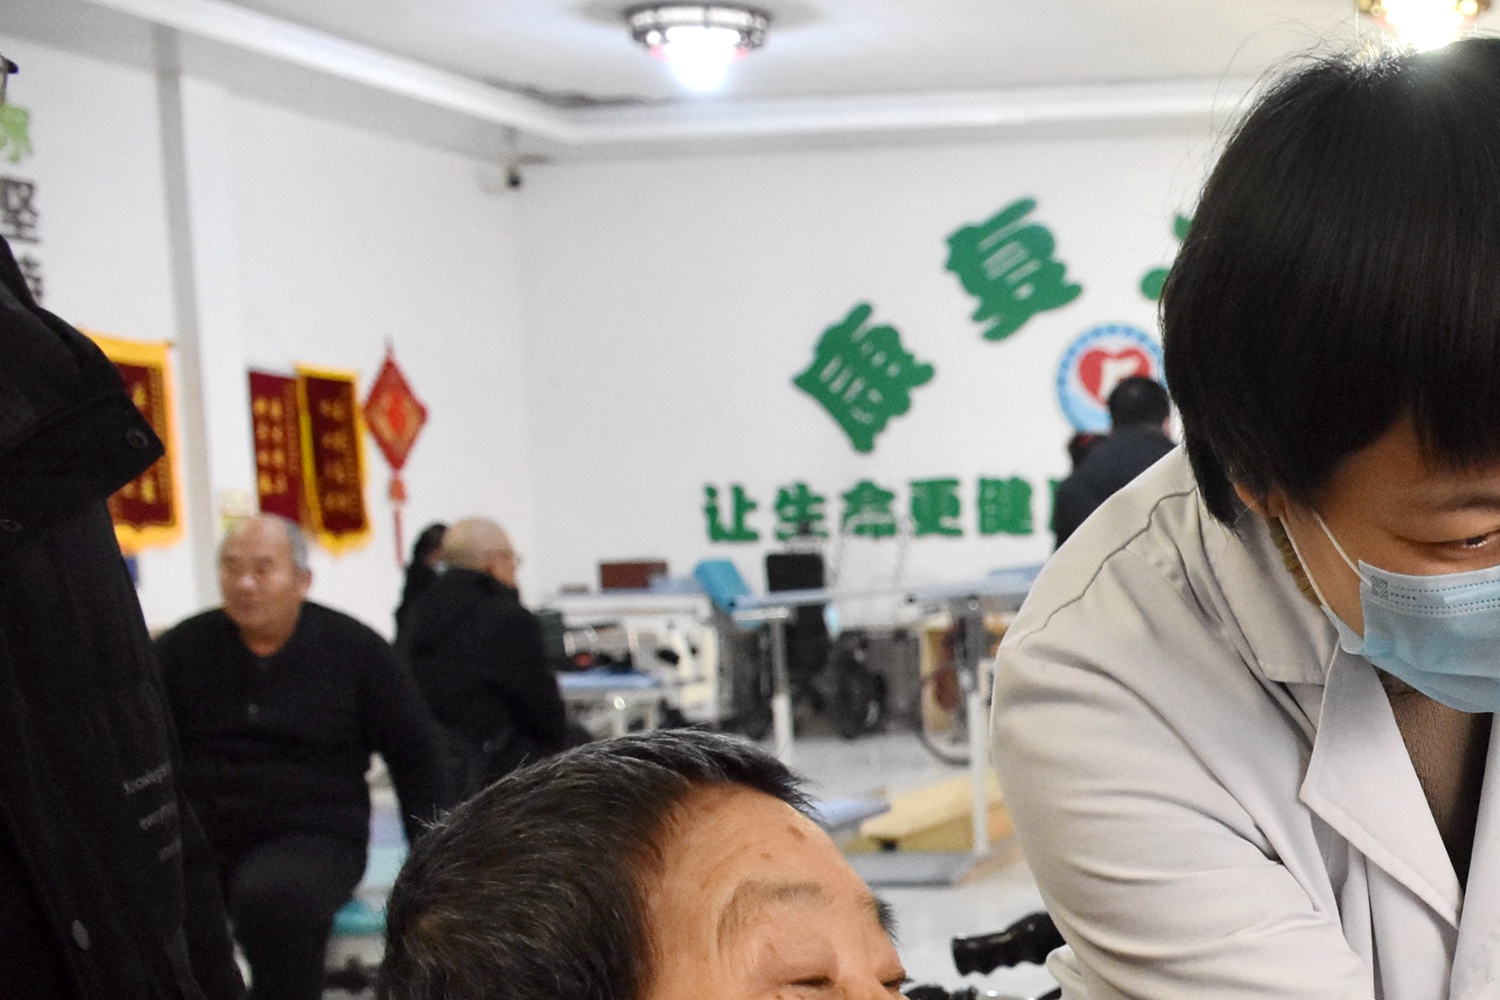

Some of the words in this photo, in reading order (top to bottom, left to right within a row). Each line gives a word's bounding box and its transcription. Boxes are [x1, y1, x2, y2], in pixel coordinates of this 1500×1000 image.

[704, 476, 1060, 542] 让生命更健
